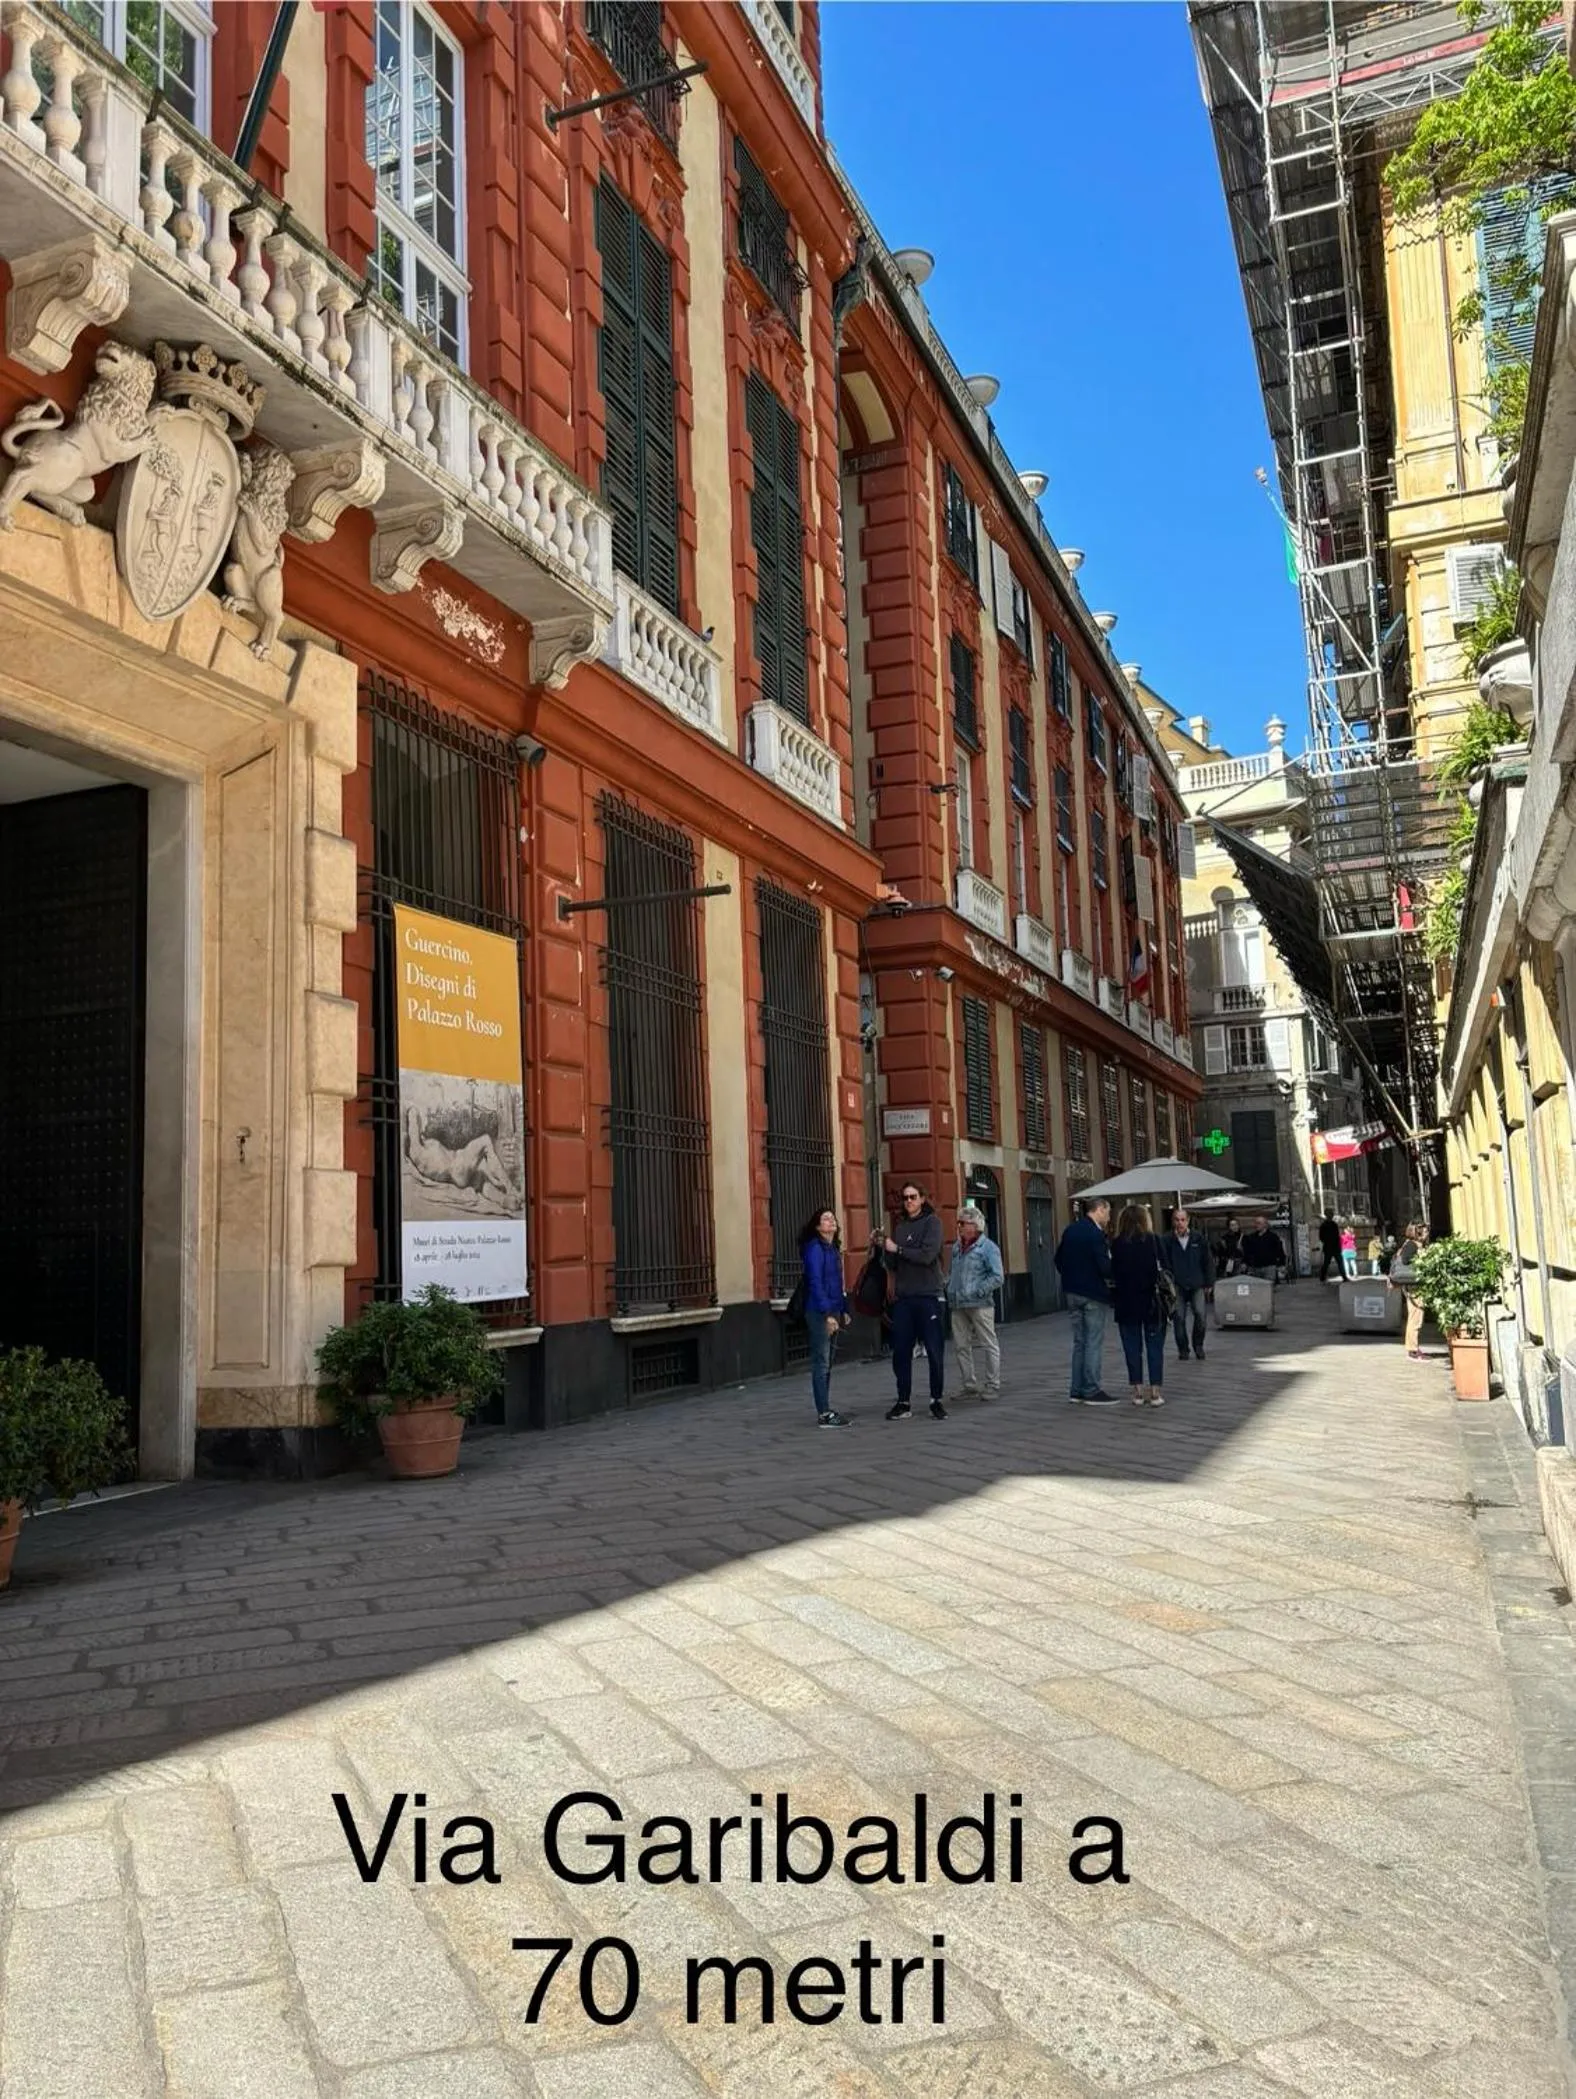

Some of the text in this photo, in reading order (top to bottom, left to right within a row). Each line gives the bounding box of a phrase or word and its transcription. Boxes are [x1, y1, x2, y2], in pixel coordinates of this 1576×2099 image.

[406, 962, 477, 1000] Disegni di
[407, 997, 503, 1038] Palazzo Rosso
